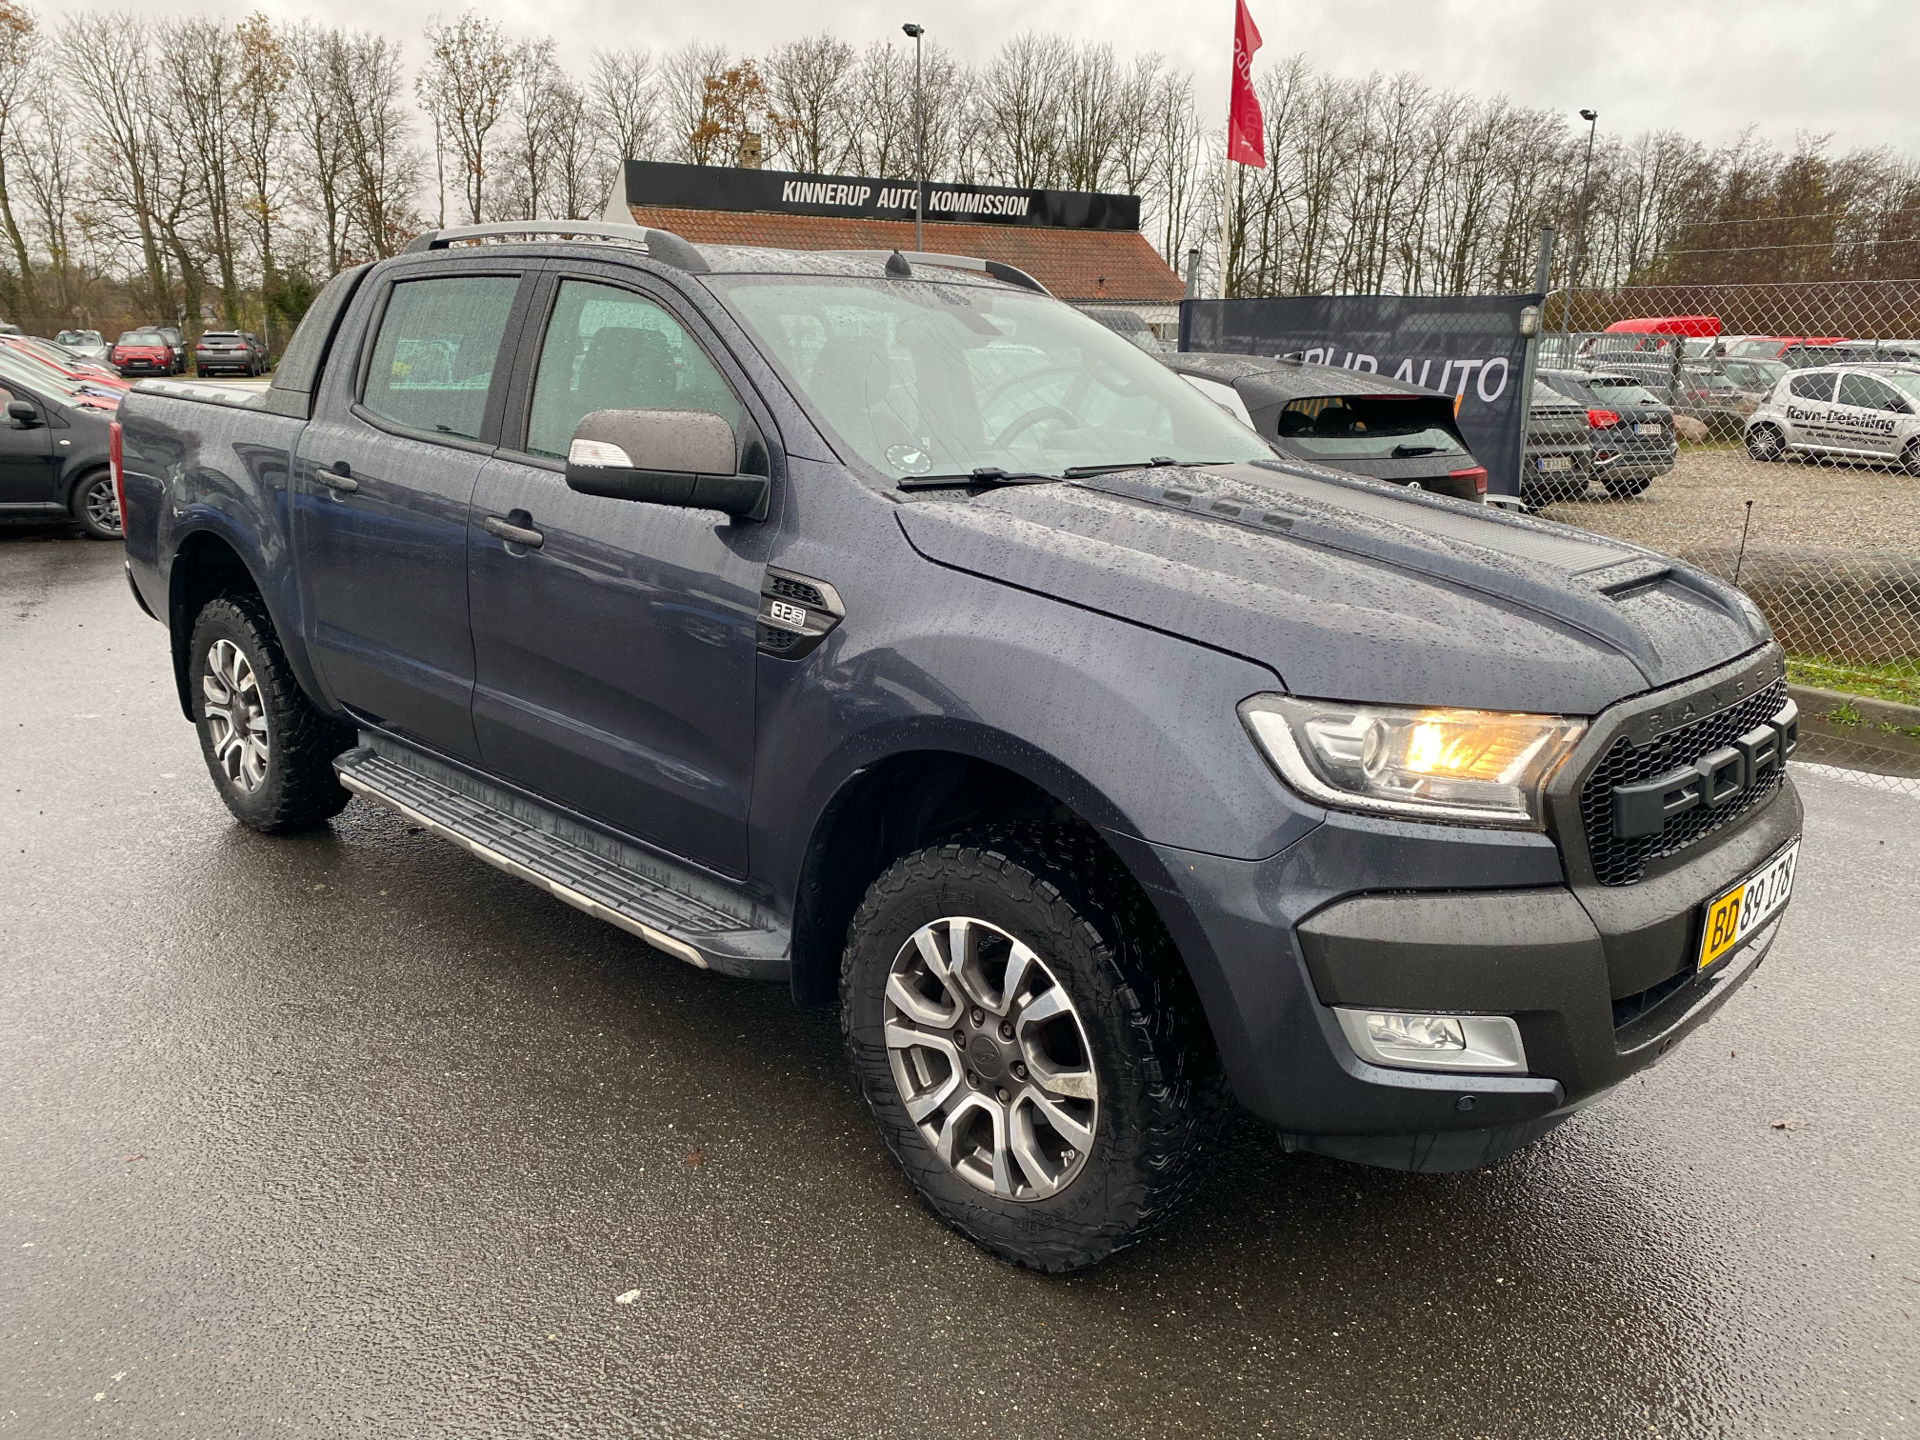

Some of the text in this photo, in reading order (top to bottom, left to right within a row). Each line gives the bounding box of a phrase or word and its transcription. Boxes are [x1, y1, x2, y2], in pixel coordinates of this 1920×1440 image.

[782, 181, 1029, 216] KINNERUP AUTO KOMMISSION
[1392, 357, 1509, 402] AUTO
[1613, 697, 1798, 839] FORD
[1710, 852, 1793, 954] BD 89 178
